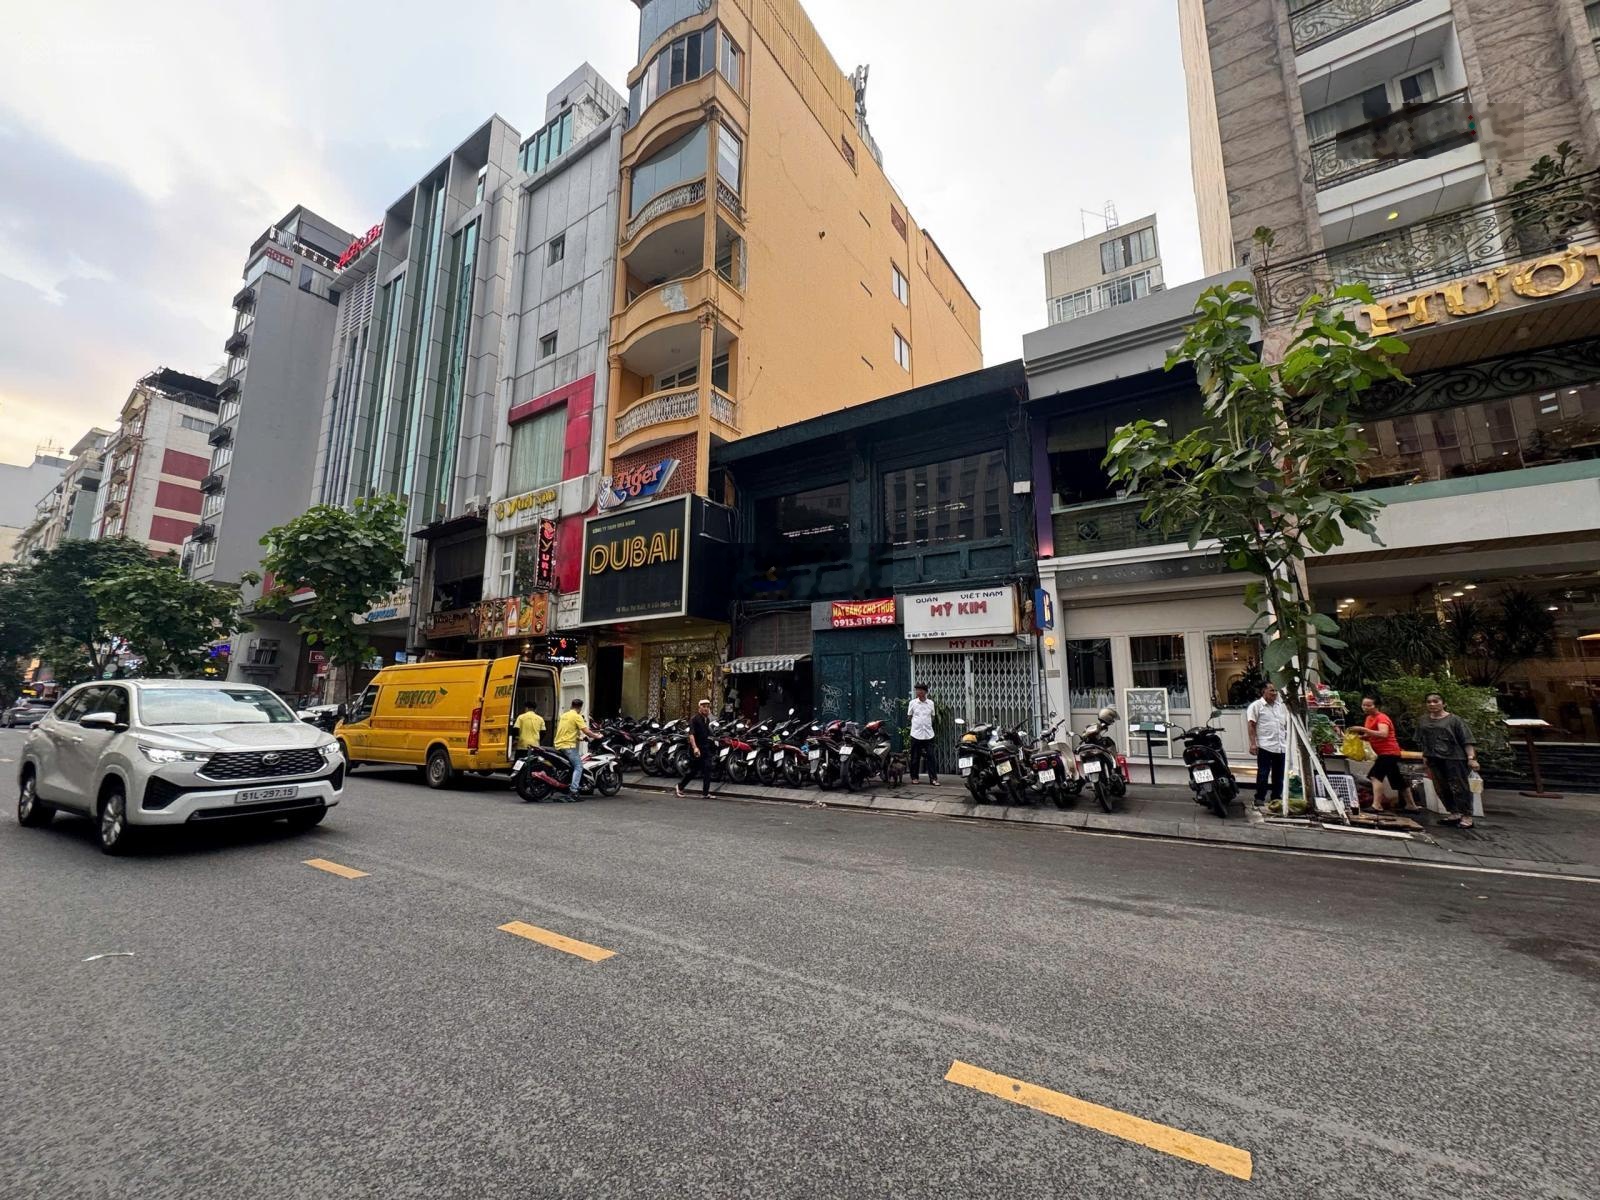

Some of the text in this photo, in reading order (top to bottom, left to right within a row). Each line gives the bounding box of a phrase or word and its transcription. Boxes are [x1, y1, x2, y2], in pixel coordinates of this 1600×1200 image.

[615, 463, 662, 496] Tiger
[589, 528, 679, 575] DUBAI
[983, 590, 1003, 598] NAM
[958, 600, 987, 615] KIM
[970, 639, 994, 648] KIM
[242, 788, 294, 800] 51L-297.15
